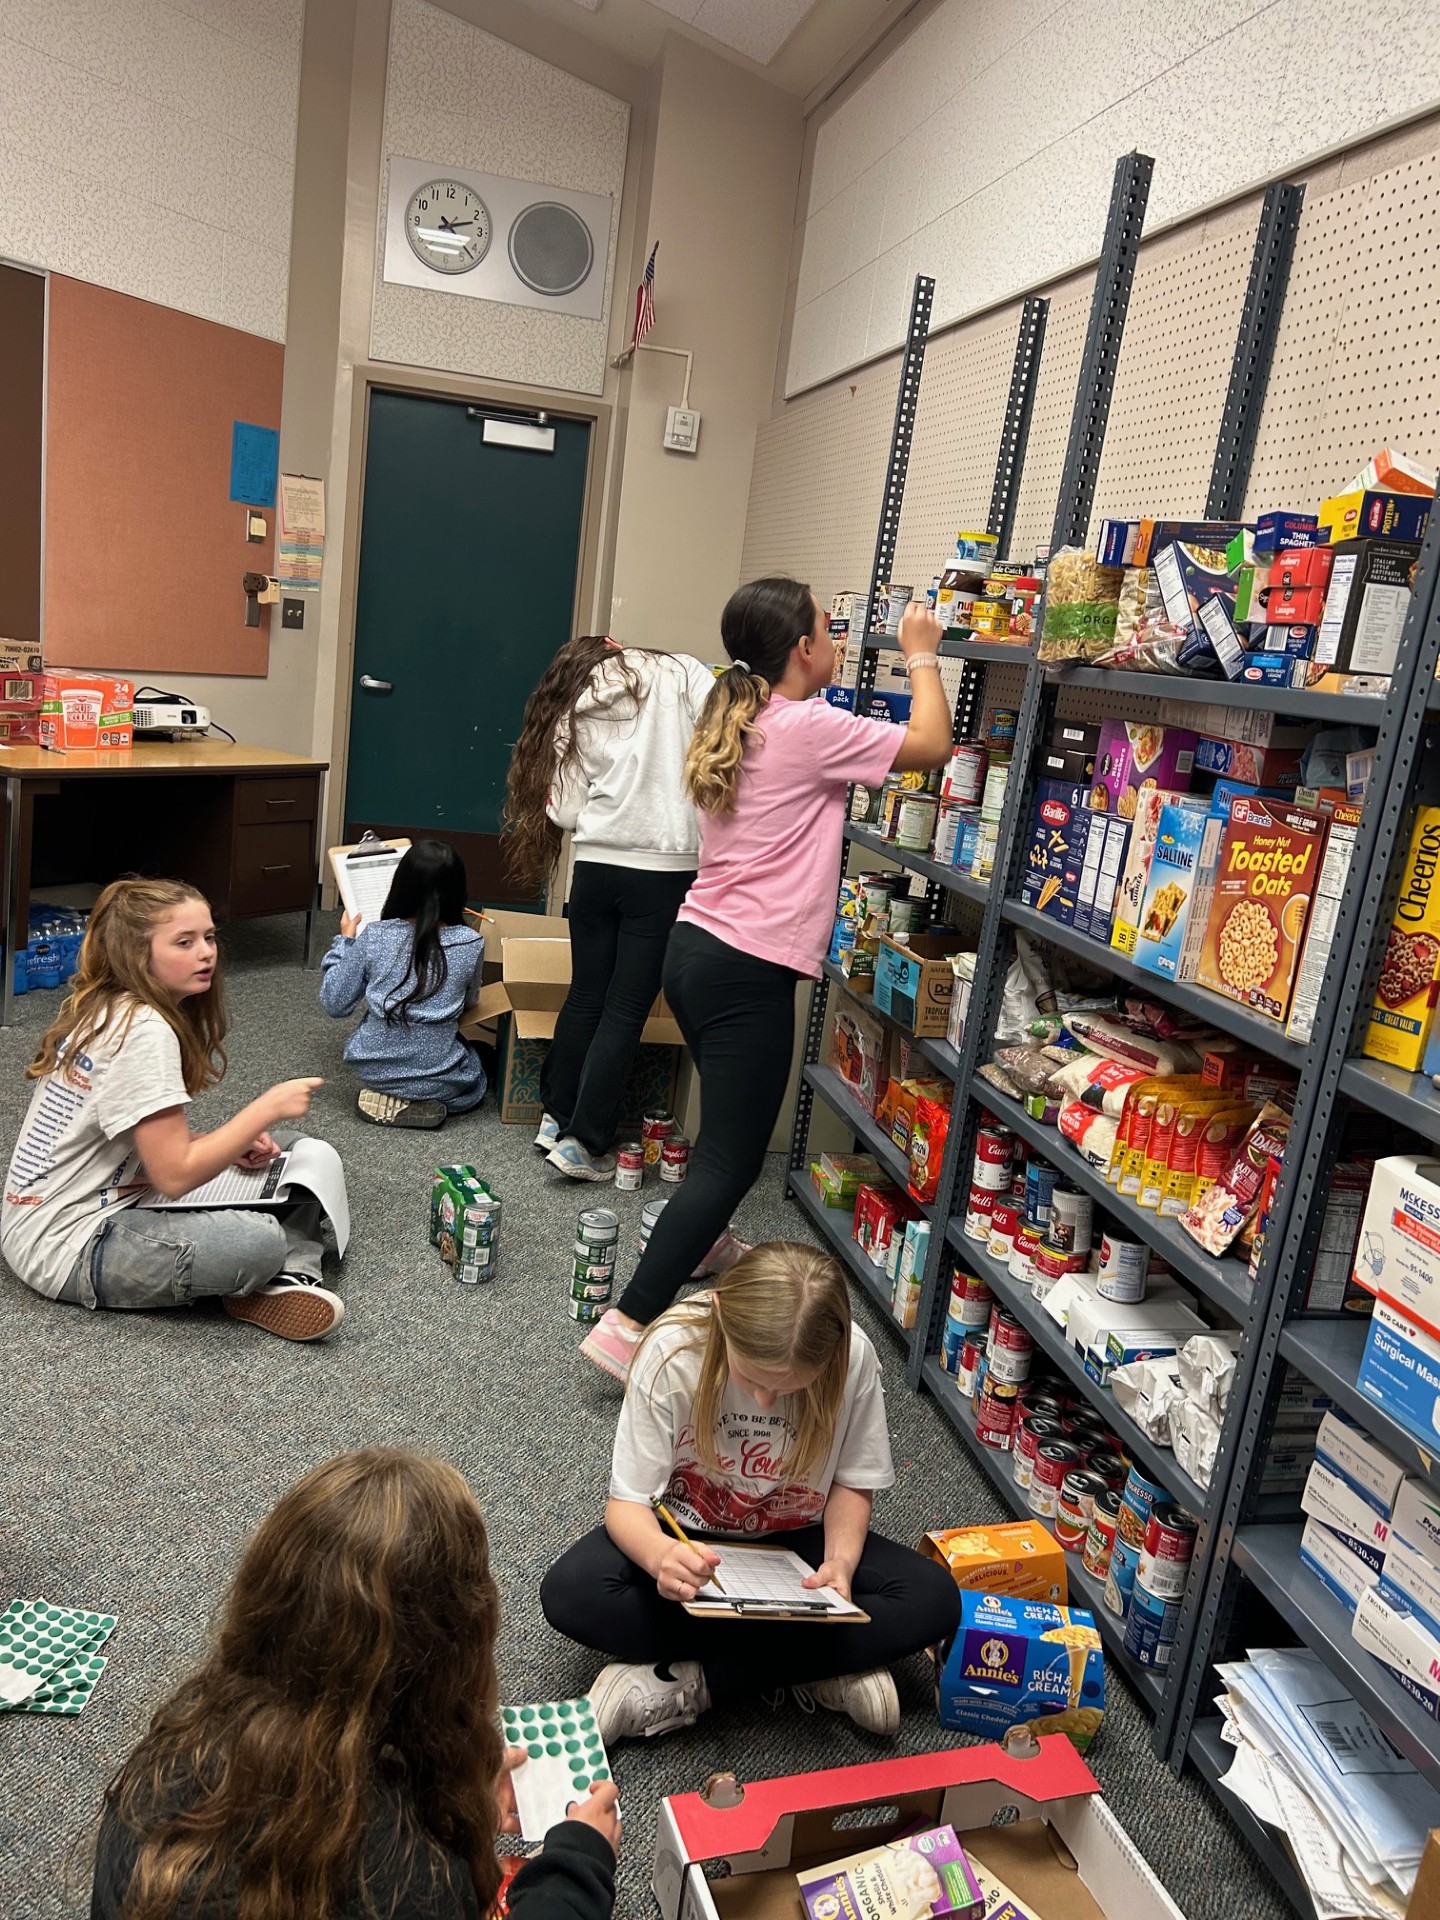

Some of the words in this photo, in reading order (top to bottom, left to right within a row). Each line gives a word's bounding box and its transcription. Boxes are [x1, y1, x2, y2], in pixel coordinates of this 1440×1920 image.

[431, 188, 439, 200] 11
[446, 187, 456, 199] 12
[464, 196, 468, 206] 1
[418, 199, 428, 210] 10
[414, 215, 421, 226] 9
[473, 210, 480, 221] 2
[476, 227, 483, 237] 3
[443, 254, 449, 264] 6
[458, 252, 465, 262] 5
[1292, 531, 1310, 541] THIN
[114, 683, 129, 693] 24
[837, 689, 845, 697] 18
[832, 695, 849, 703] pack
[73, 703, 92, 713] CUP
[996, 715, 1016, 725] BUSH'S
[1113, 747, 1126, 789] Crackers
[1072, 788, 1079, 805] 6
[1042, 804, 1067, 822] Barilla
[1234, 803, 1249, 820] GF
[1247, 811, 1272, 827] Brands
[1253, 834, 1276, 848] Honey
[1276, 836, 1291, 848] Nut
[1156, 843, 1194, 869] SALTINE
[1227, 841, 1313, 875] Toasted
[1398, 823, 1440, 922] Cheerios
[1133, 871, 1145, 907] QUAKER
[1251, 872, 1293, 897] Oats
[1061, 1111, 1081, 1130] Grain
[1409, 1263, 1434, 1285] 91-1400
[1379, 1309, 1392, 1322] BYD
[1392, 1317, 1408, 1333] CARE
[1373, 1333, 1416, 1371] Surgical
[1415, 1362, 1440, 1390] Mas
[731, 1412, 748, 1421] TO
[751, 1414, 767, 1425] BE
[727, 1428, 750, 1439] SINCE
[753, 1429, 772, 1438] 1998
[1313, 1467, 1335, 1488] TRONEX
[689, 1510, 702, 1526] THE
[1373, 1520, 1389, 1542] M
[1348, 1538, 1380, 1570] 8530-20
[975, 1604, 1013, 1618] Annie's
[1024, 1605, 1051, 1615] RICH
[1052, 1607, 1060, 1616] &
[1367, 1594, 1390, 1619] TRONEX
[974, 1618, 994, 1626] Classic
[994, 1621, 1018, 1630] Cheddar
[1089, 1653, 1096, 1663] 4
[964, 1663, 1020, 1685] Annie's
[1033, 1669, 1062, 1684] RICH
[1063, 1675, 1074, 1686] &
[1428, 1658, 1440, 1683] M
[1027, 1681, 1081, 1700] CREAMY
[1400, 1674, 1434, 1713] 8530-20
[955, 1708, 981, 1719] Classic
[981, 1713, 1012, 1725] Cheddar
[873, 1862, 890, 1892] Cheddar
